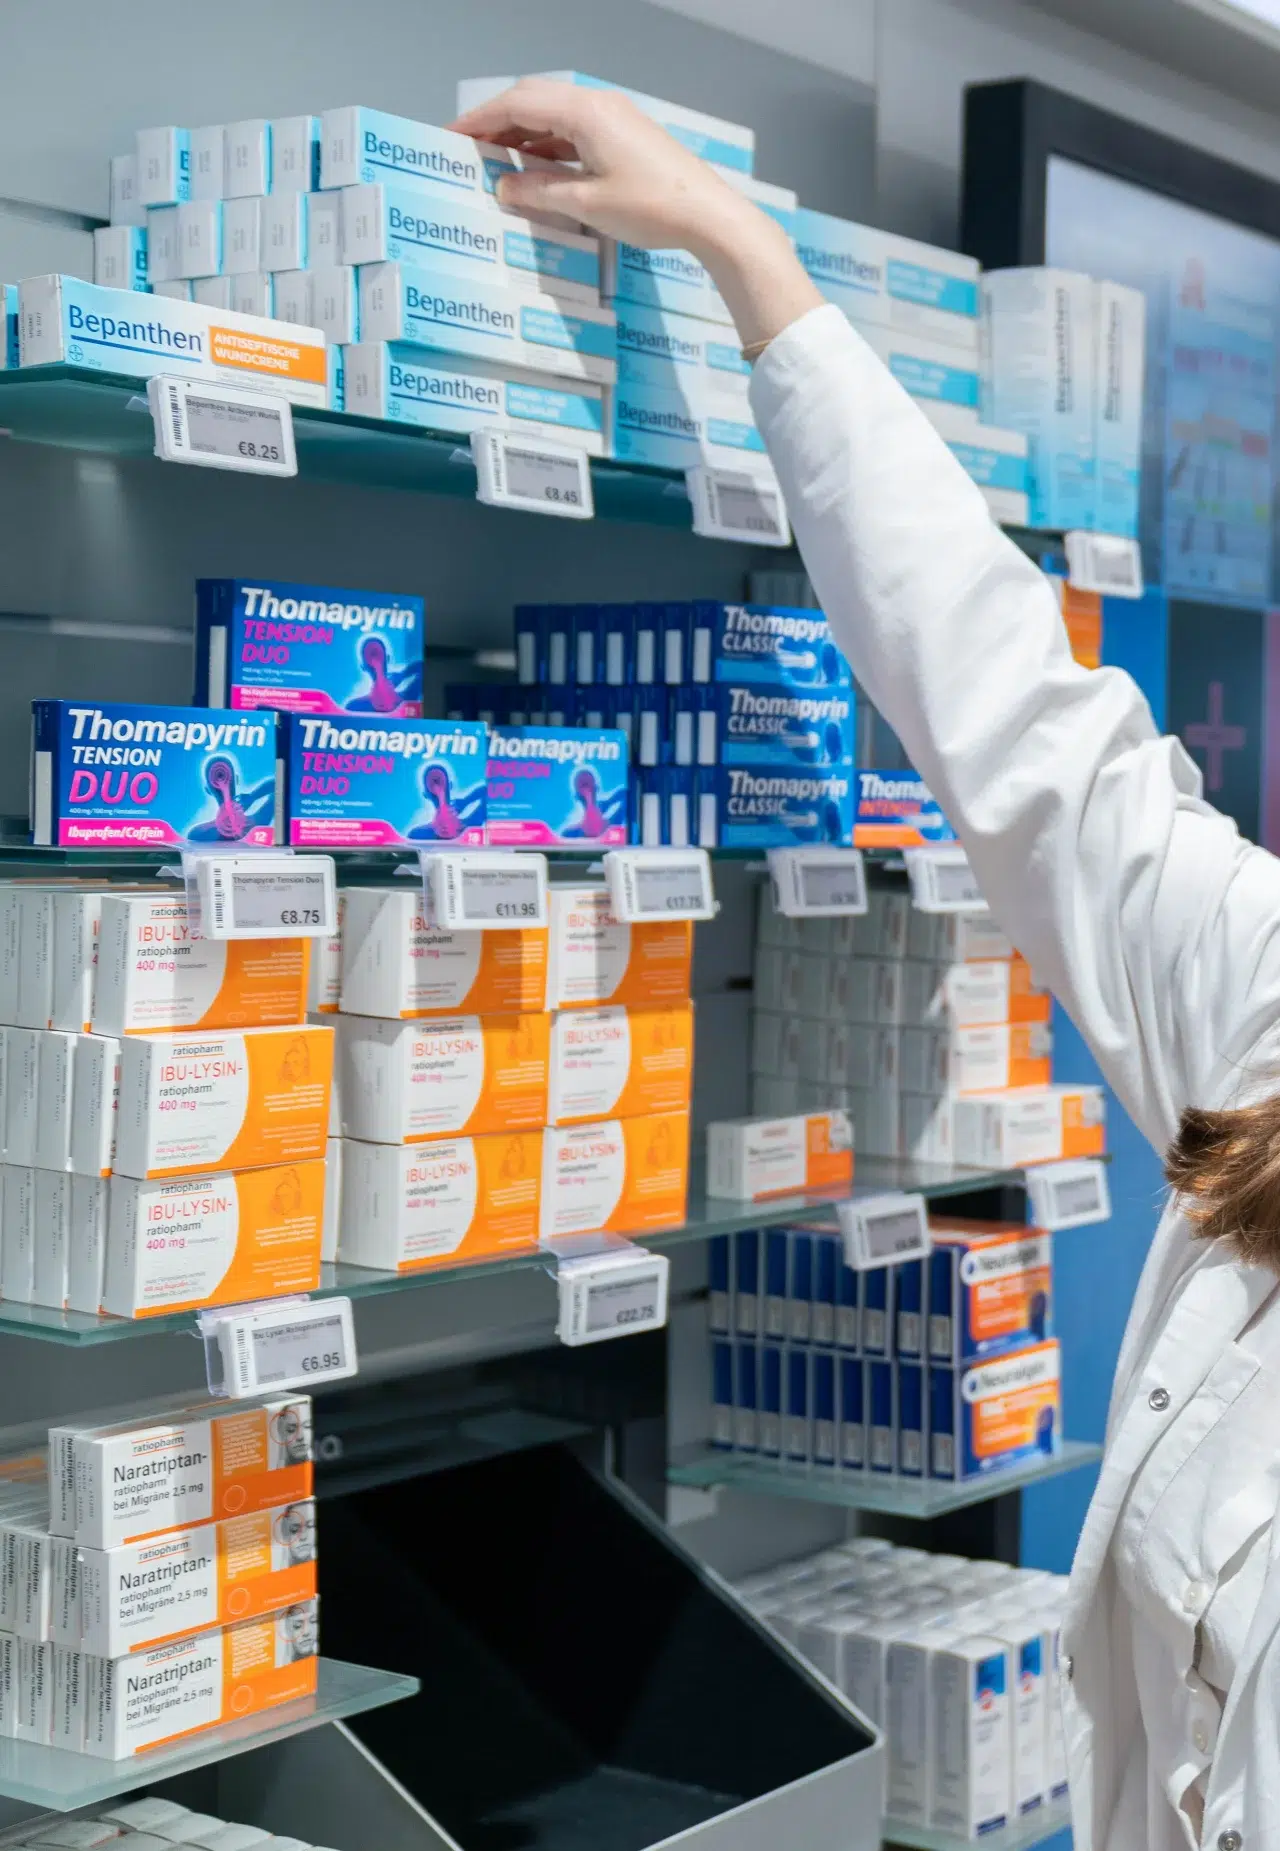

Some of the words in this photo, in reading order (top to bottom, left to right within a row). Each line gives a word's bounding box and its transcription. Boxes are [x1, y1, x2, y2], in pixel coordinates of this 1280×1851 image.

[365, 131, 476, 180] Bepanthen
[389, 207, 497, 253] Bepanthen
[621, 243, 704, 280] Bepanthen
[406, 286, 514, 331] Bepanthen
[69, 304, 202, 352] Bepanthen
[616, 321, 700, 357] Bepanthen
[214, 333, 300, 361] ANTISEPTISCHE
[214, 347, 289, 371] WUNDCREME
[390, 365, 498, 405] Bepanthen
[618, 402, 700, 435] Bepanthen
[238, 441, 279, 460] €8.25
[241, 587, 415, 631] Thomapyrin
[242, 620, 334, 645] TENSION
[724, 606, 831, 642] Thomapyr
[722, 632, 784, 651] CLASSIC
[241, 643, 290, 665] DUO
[729, 688, 848, 721] Thomapyrin
[68, 708, 266, 751] Thomapyrin
[728, 715, 788, 734] CLASSIC
[300, 719, 478, 759] Thomapyrin
[487, 730, 619, 764] homapyrin
[71, 746, 161, 767] TENSION
[302, 752, 395, 773] TENSION
[69, 770, 159, 804] DUO
[301, 776, 349, 796] DUO
[487, 782, 515, 799] UO
[728, 771, 848, 801] Thomapyrin
[727, 798, 788, 815] CLASSIC
[68, 826, 164, 841] Ibuprofen/Coffein
[254, 831, 267, 842] 12
[233, 876, 275, 885] Thomapyrin
[277, 876, 304, 884] Tension
[281, 909, 320, 924] €8.75
[496, 903, 536, 916] €11.95
[136, 945, 191, 957] ratiopharm
[136, 960, 155, 971] 400
[158, 962, 176, 972] mg
[173, 1045, 223, 1057] ratiopharm
[160, 1061, 243, 1082] IBU-LYSIN-
[159, 1084, 213, 1097] ratiopharm
[159, 1100, 178, 1111] 400
[180, 1100, 197, 1111] mg
[161, 1182, 212, 1195] ratiopharm
[148, 1198, 233, 1221] IBU-LYSIN-
[146, 1221, 201, 1236] ratiopharm
[146, 1239, 165, 1250] 400
[168, 1238, 185, 1248] mg
[302, 1352, 340, 1371] €6.95
[133, 1435, 184, 1454] ratiopharm
[114, 1452, 208, 1484] Naratriptan-
[113, 1498, 128, 1511] bei
[131, 1491, 170, 1509] Migräne
[172, 1486, 186, 1498] 2,5
[188, 1482, 204, 1494] mg
[114, 1478, 167, 1497] ratiopharm
[139, 1540, 189, 1561] ratiopharm
[119, 1556, 212, 1590] Naratriptan-
[119, 1606, 134, 1619] bei
[137, 1596, 175, 1616] Migräne
[177, 1591, 191, 1603] 2,5
[193, 1586, 208, 1598] mg
[120, 1583, 172, 1605] ratiopharm
[146, 1641, 196, 1662] ratiopharm
[127, 1655, 218, 1694] Naratriptan-
[126, 1709, 140, 1721] bei
[143, 1697, 181, 1718] Migräne
[183, 1691, 197, 1703] 2,5
[198, 1686, 213, 1698] mg
[127, 1686, 179, 1708] ratiopharm
